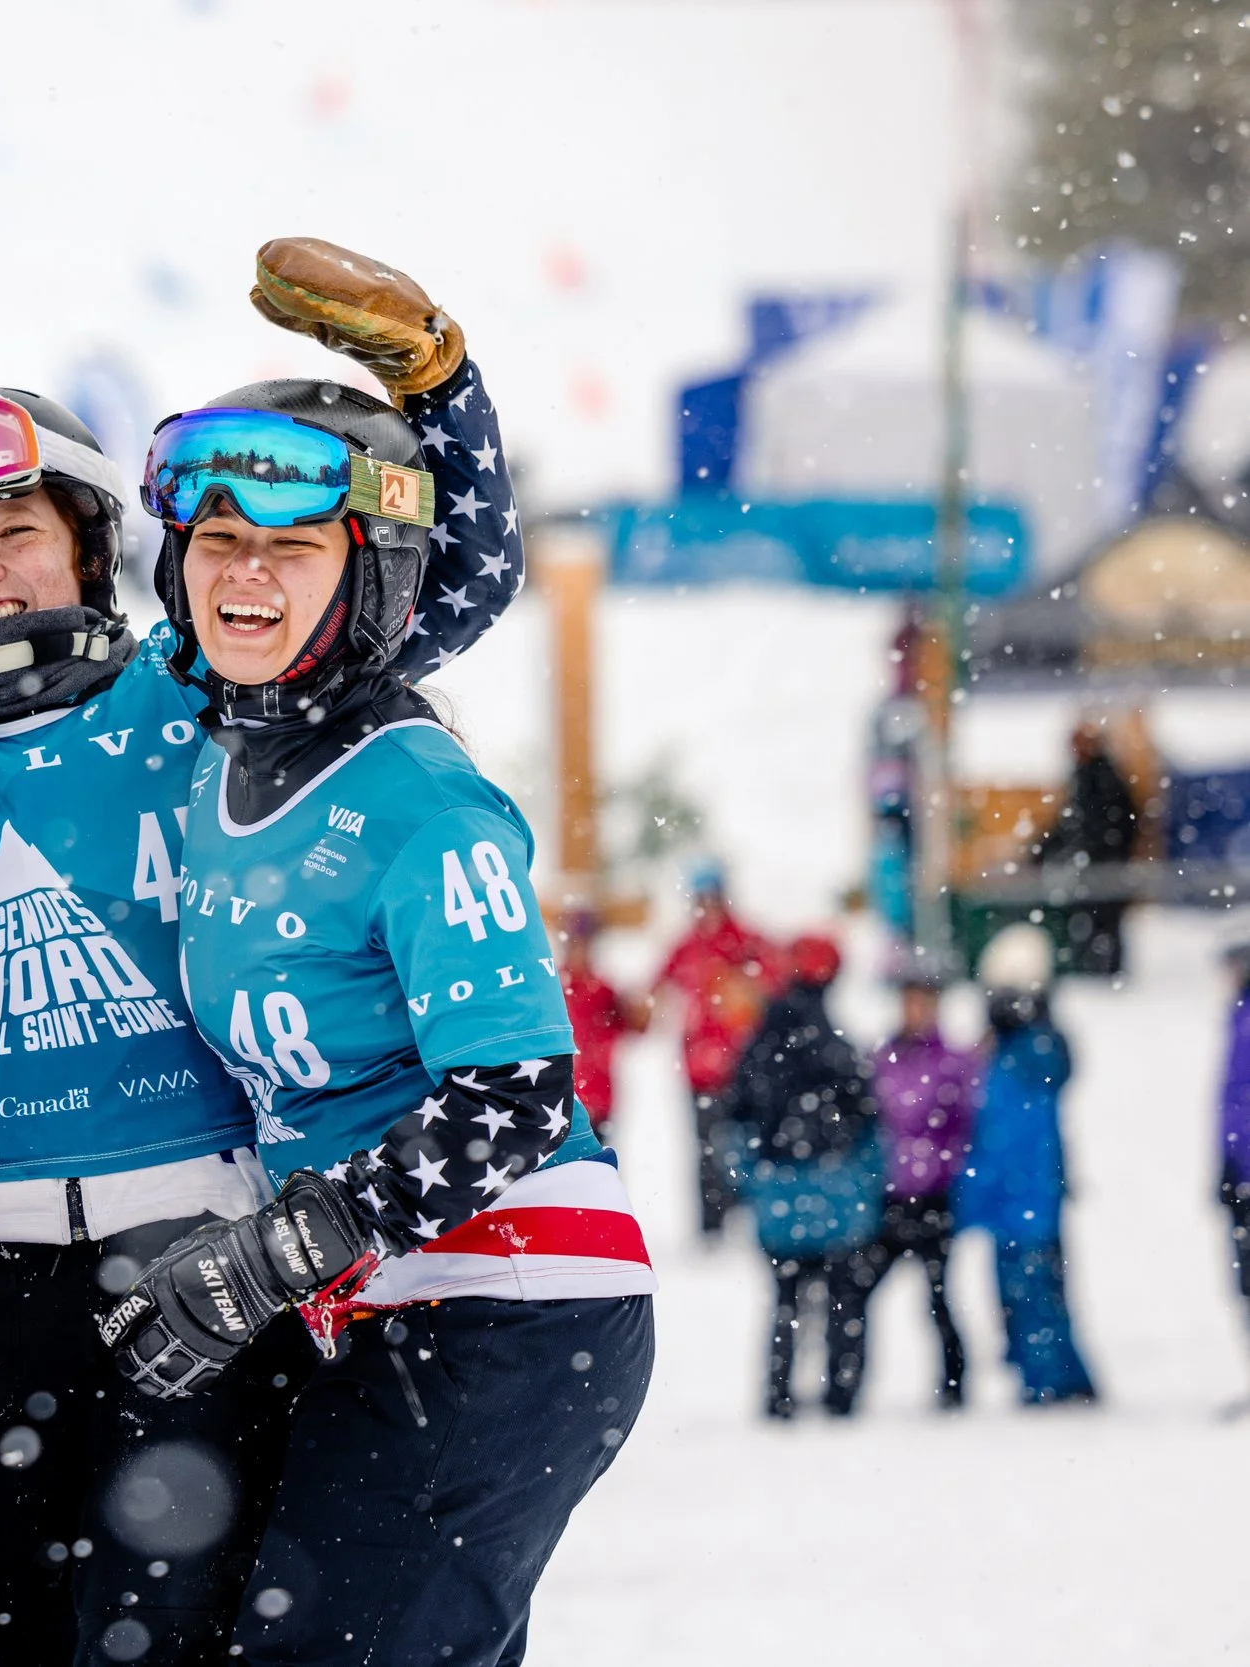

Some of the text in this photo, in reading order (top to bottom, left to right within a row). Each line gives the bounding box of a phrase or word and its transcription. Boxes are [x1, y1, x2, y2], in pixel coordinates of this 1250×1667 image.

[327, 804, 366, 838] VISA
[133, 805, 189, 924] 4
[325, 868, 338, 878] CUP
[442, 841, 527, 943] 48
[22, 994, 187, 1052] SAINT-CÔME
[229, 989, 331, 1089] 48
[140, 1090, 184, 1104] HEALTH
[272, 1216, 291, 1242] RSL
[281, 1243, 308, 1275] COMP
[197, 1259, 246, 1331] SKI TEAM
